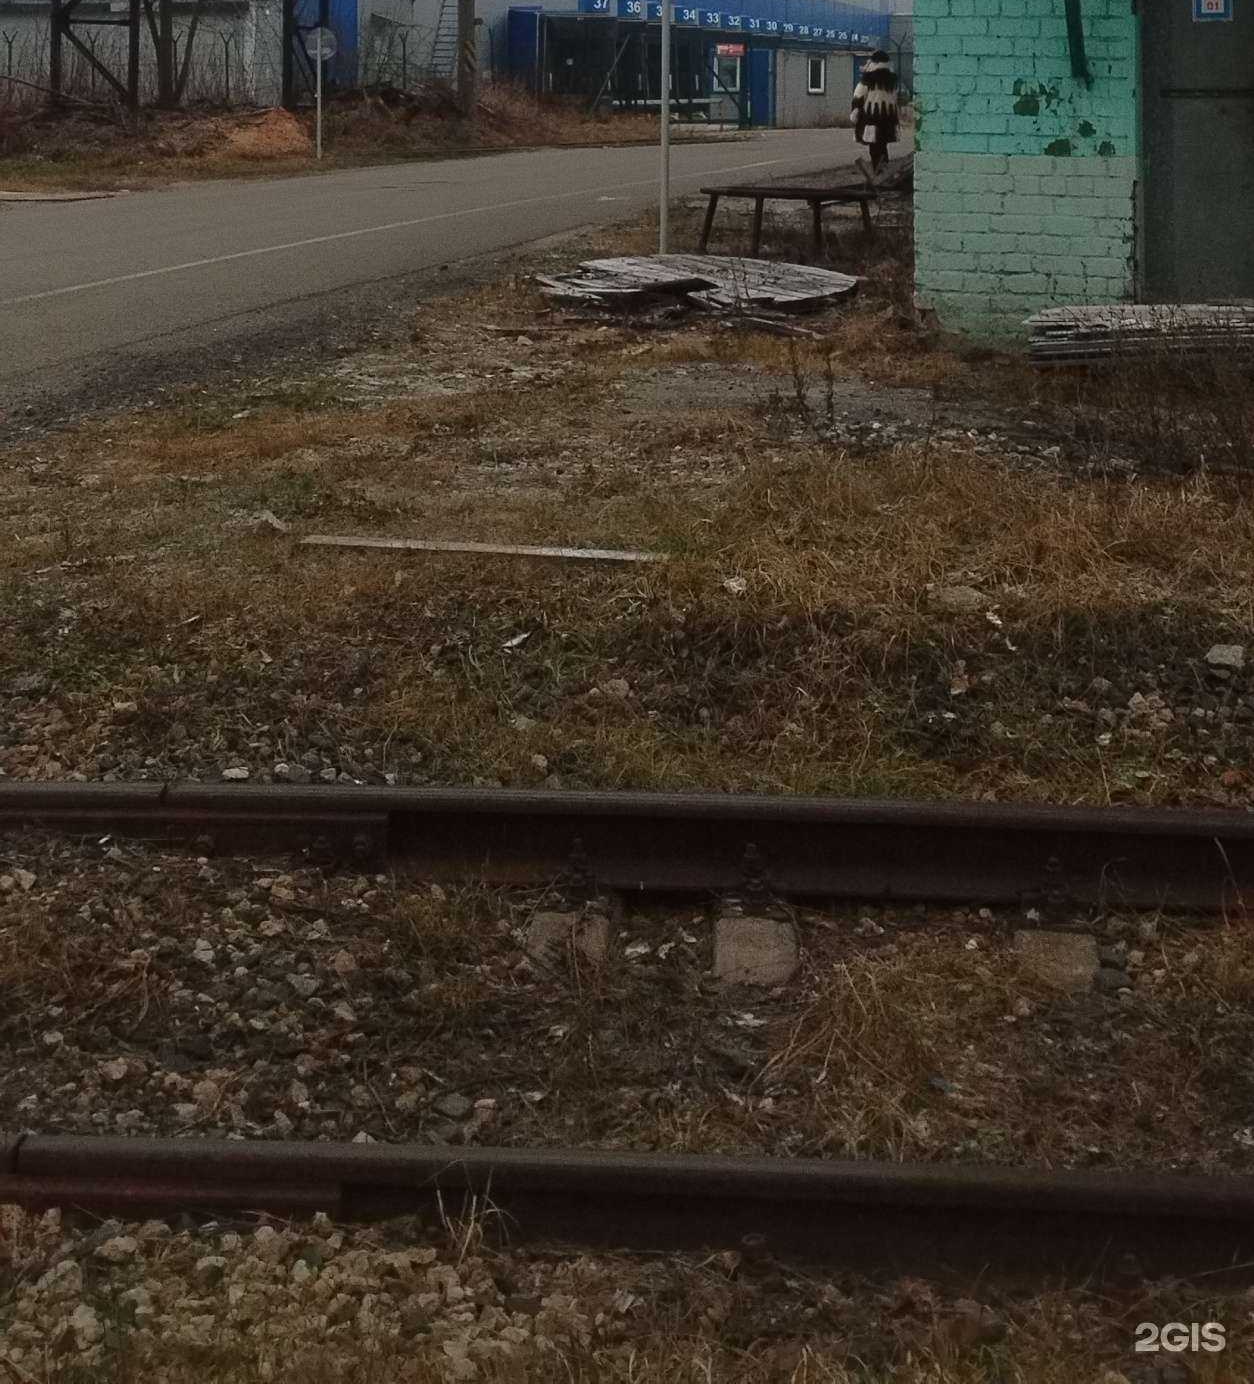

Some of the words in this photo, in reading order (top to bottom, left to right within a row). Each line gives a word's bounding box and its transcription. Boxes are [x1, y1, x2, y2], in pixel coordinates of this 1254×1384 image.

[1207, 1, 1219, 10] 01
[627, 1, 640, 13] 36
[656, 5, 663, 17] 3
[683, 9, 696, 20] 34
[706, 12, 719, 24] 33
[728, 15, 740, 26] 32
[749, 18, 760, 28] 31
[766, 21, 777, 31] 30
[799, 25, 809, 35] 28
[813, 28, 822, 36] 27
